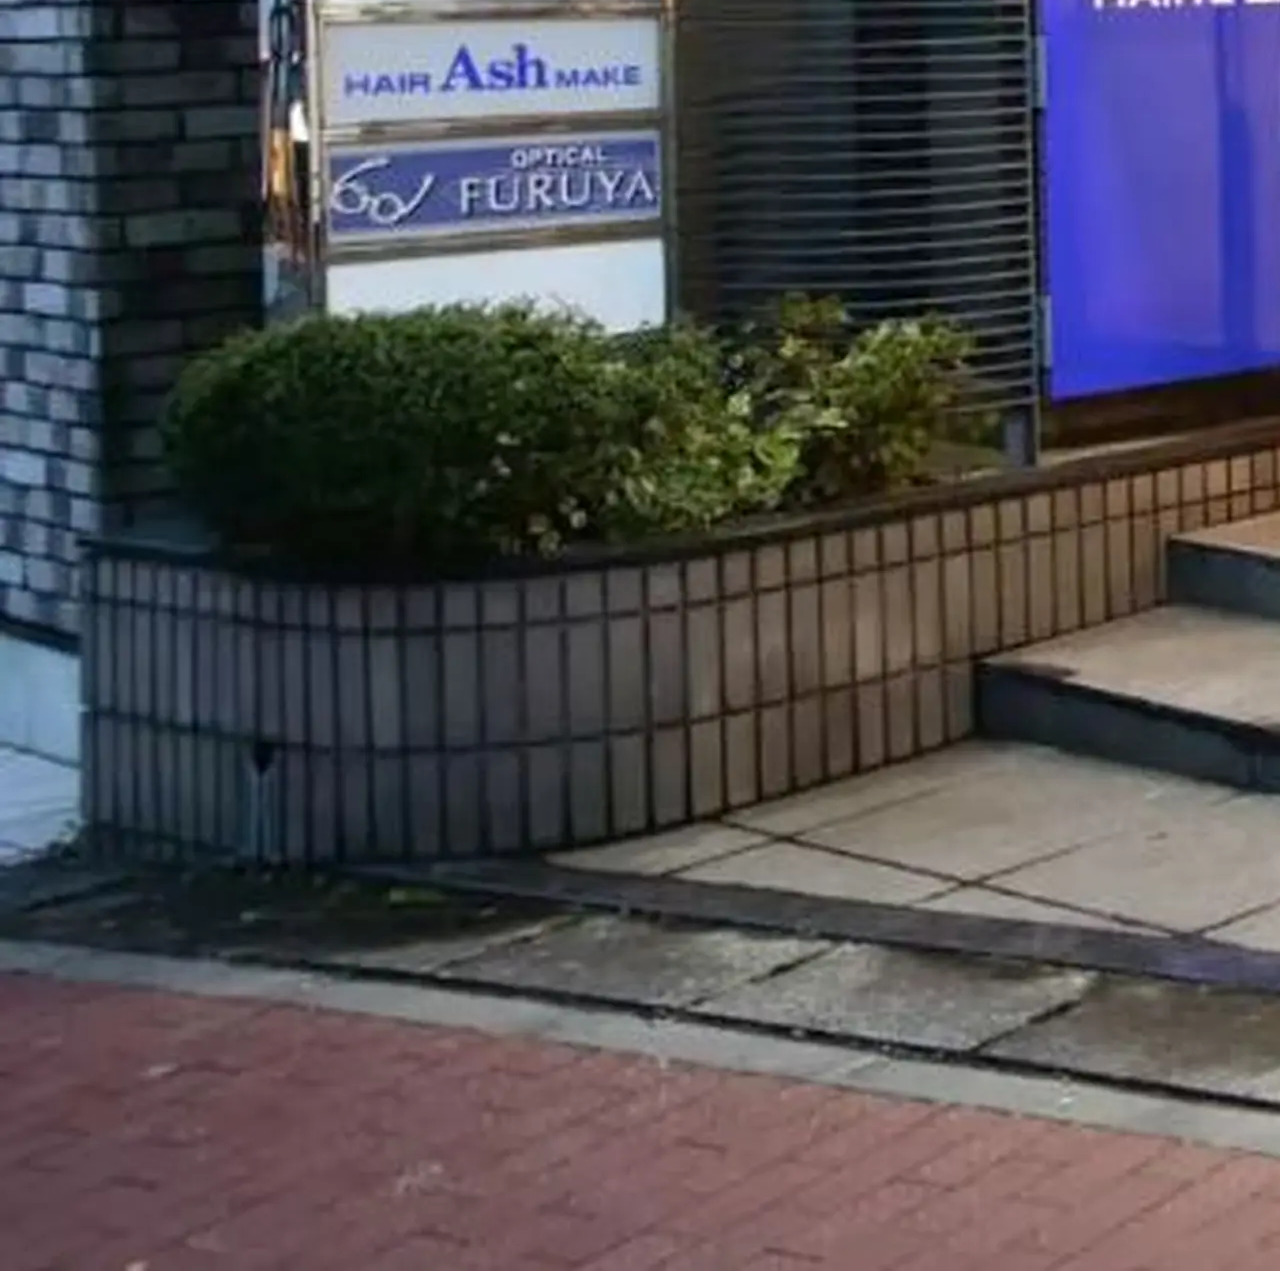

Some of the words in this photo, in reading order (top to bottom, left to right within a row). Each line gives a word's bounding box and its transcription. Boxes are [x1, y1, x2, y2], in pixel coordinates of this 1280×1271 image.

[344, 72, 431, 96] HAIR
[439, 42, 549, 92] Ash
[555, 64, 642, 89] MAKE
[511, 146, 607, 169] OPTICAL
[458, 168, 656, 215] FURUYA
